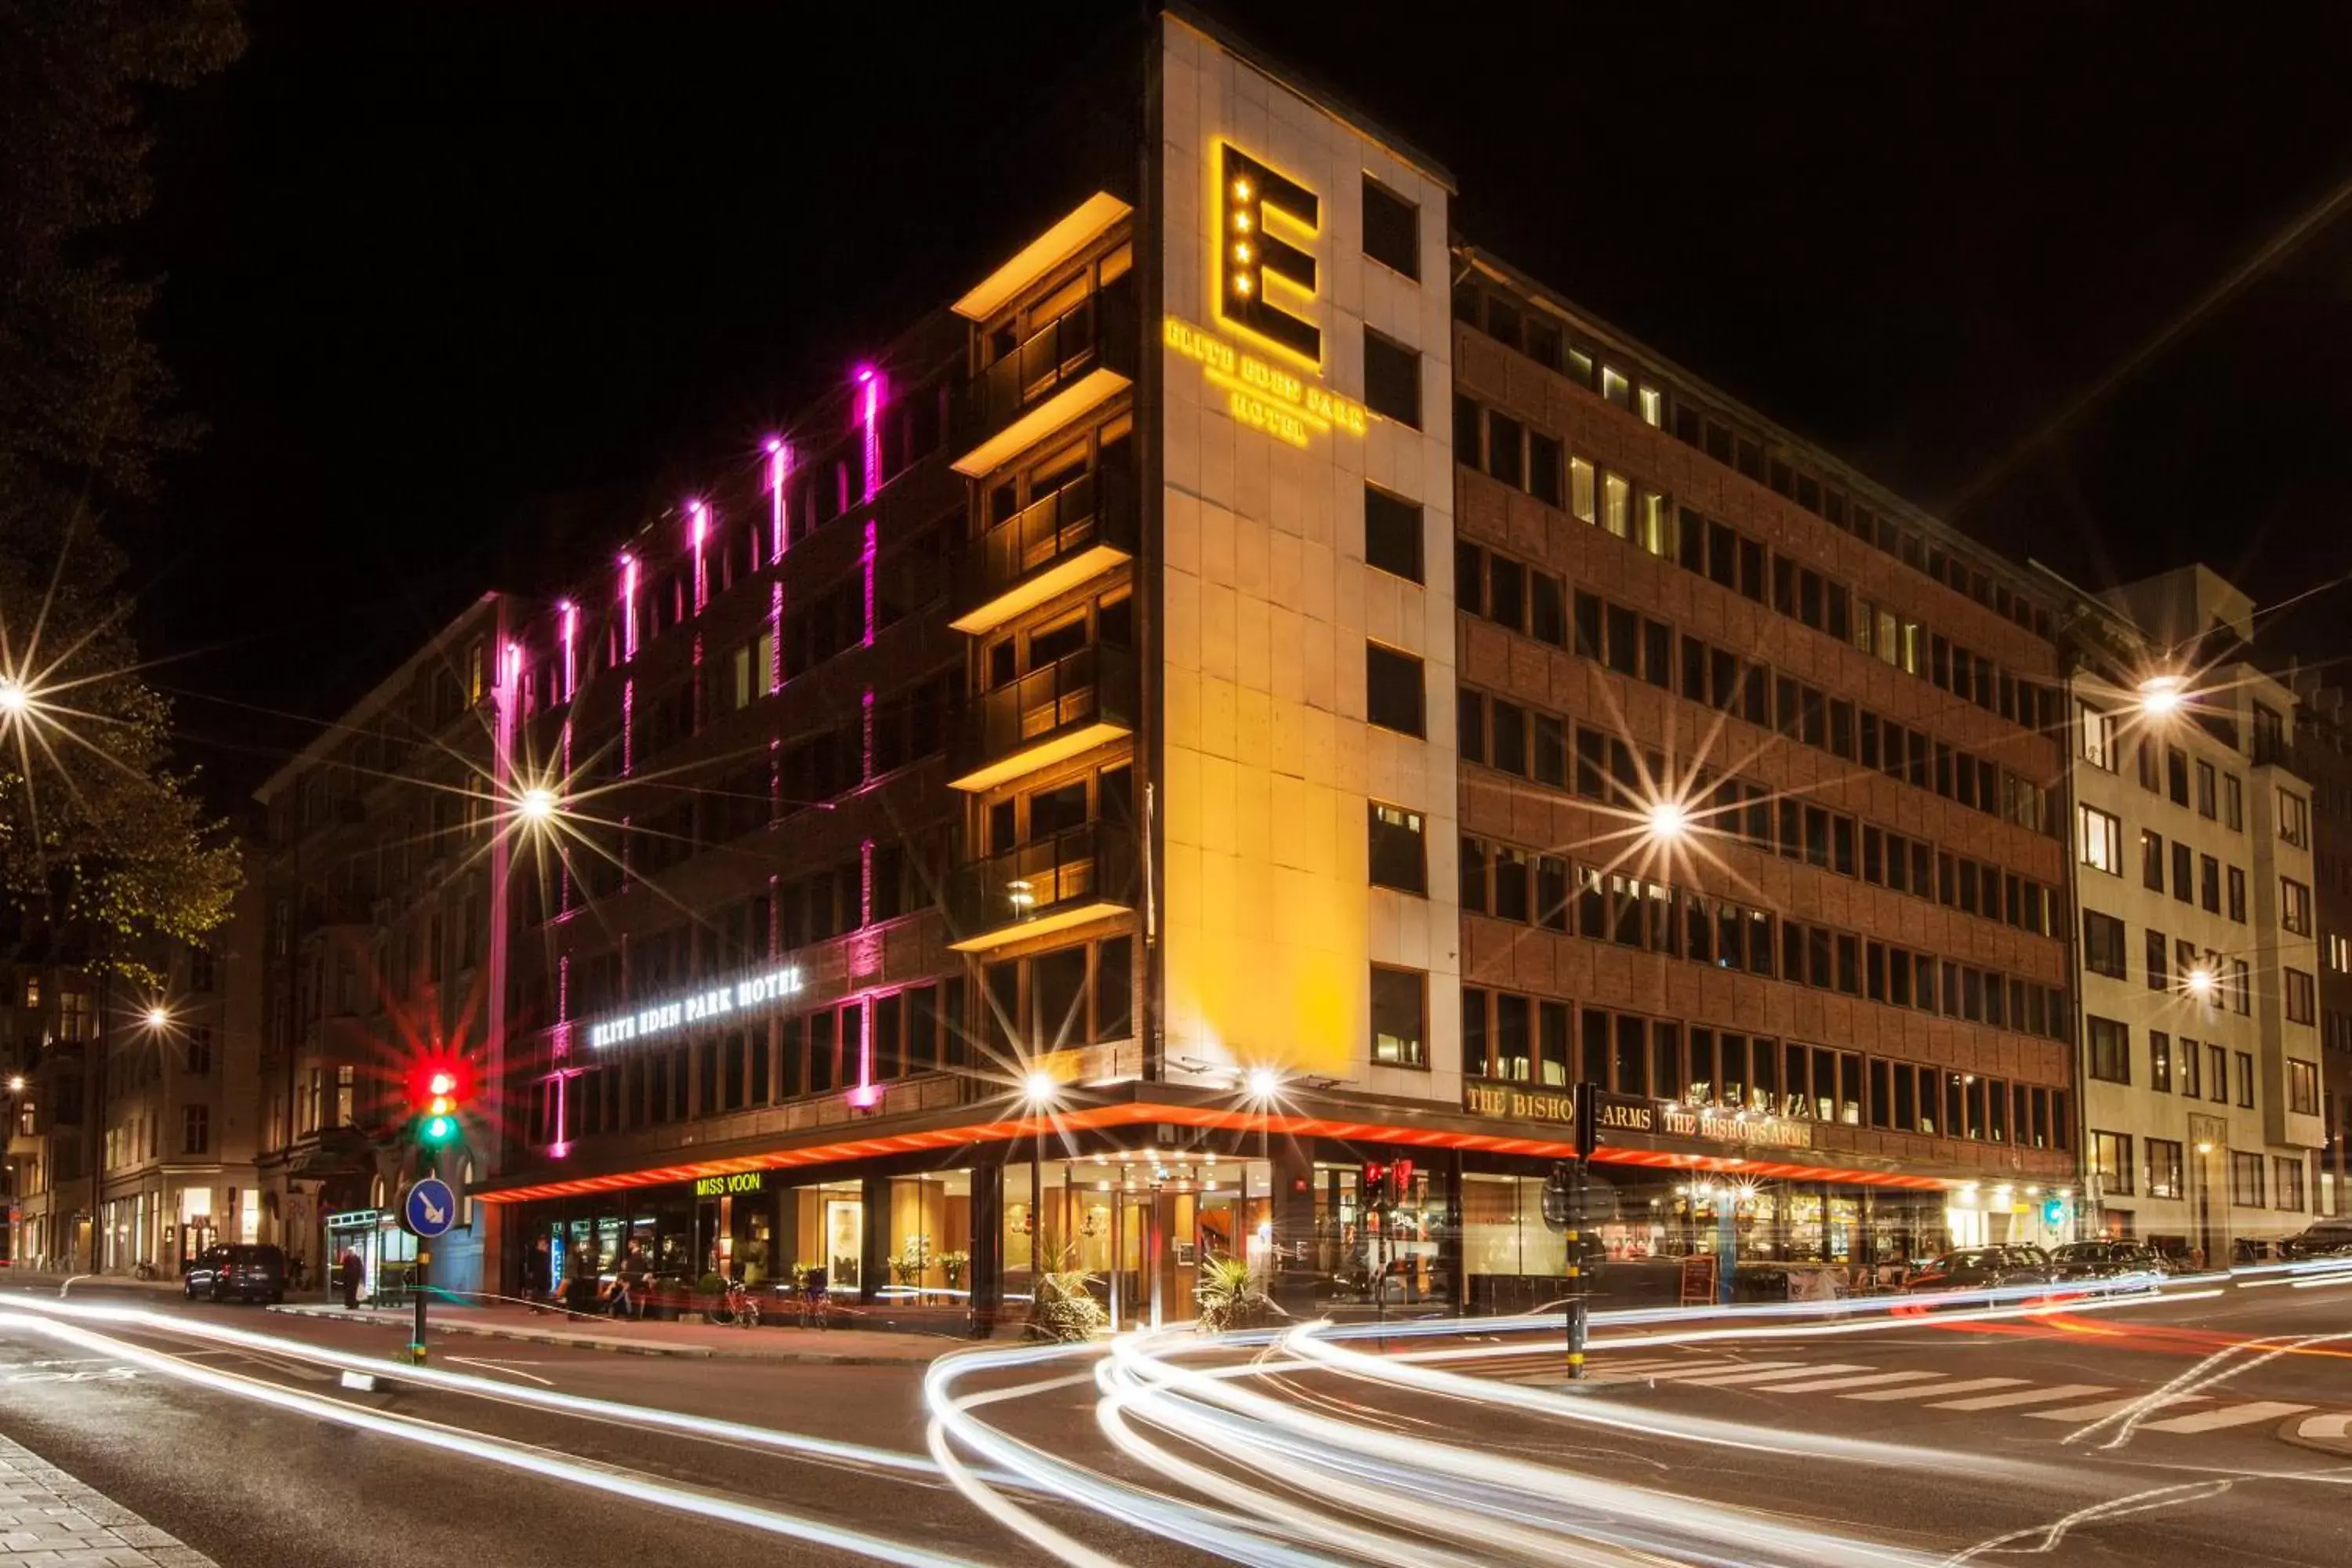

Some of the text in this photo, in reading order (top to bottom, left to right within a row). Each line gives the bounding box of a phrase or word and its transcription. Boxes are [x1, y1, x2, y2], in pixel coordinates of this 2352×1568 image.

[1213, 139, 1323, 368] E
[593, 967, 802, 1047] ELITE EDEN PARK HOTEL
[1468, 1087, 1651, 1130] THE BISHO ARMS
[1663, 1112, 1812, 1148] THE BISHOPS ARMS
[697, 1172, 760, 1196] MISS VOON
